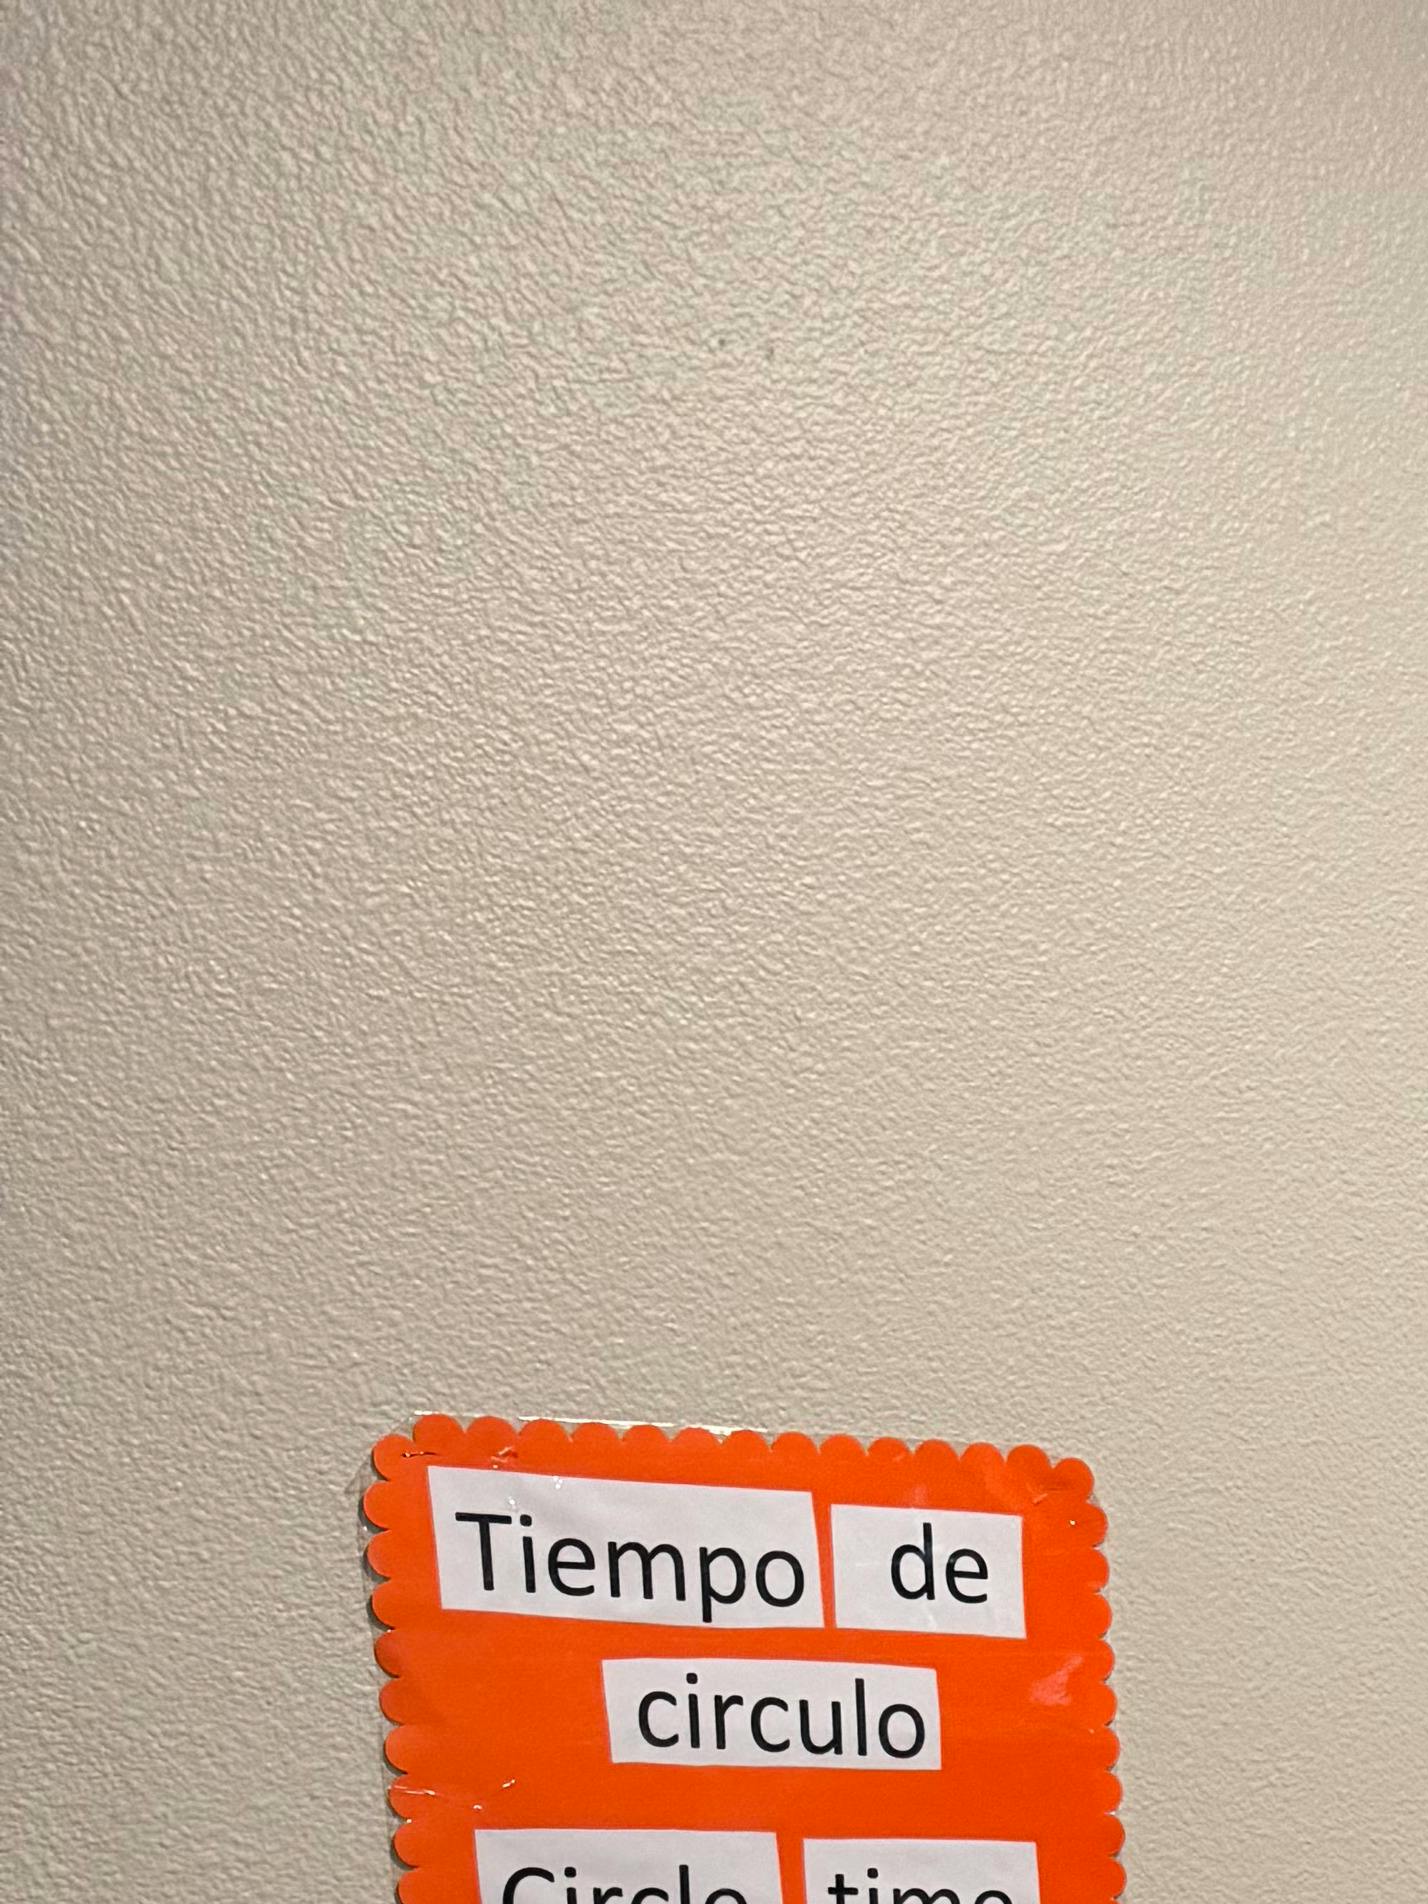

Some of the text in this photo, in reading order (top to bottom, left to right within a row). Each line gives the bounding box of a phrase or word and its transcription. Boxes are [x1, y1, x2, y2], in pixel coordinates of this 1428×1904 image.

[455, 1512, 990, 1623] Tiempo de
[638, 1672, 925, 1760] circulo
